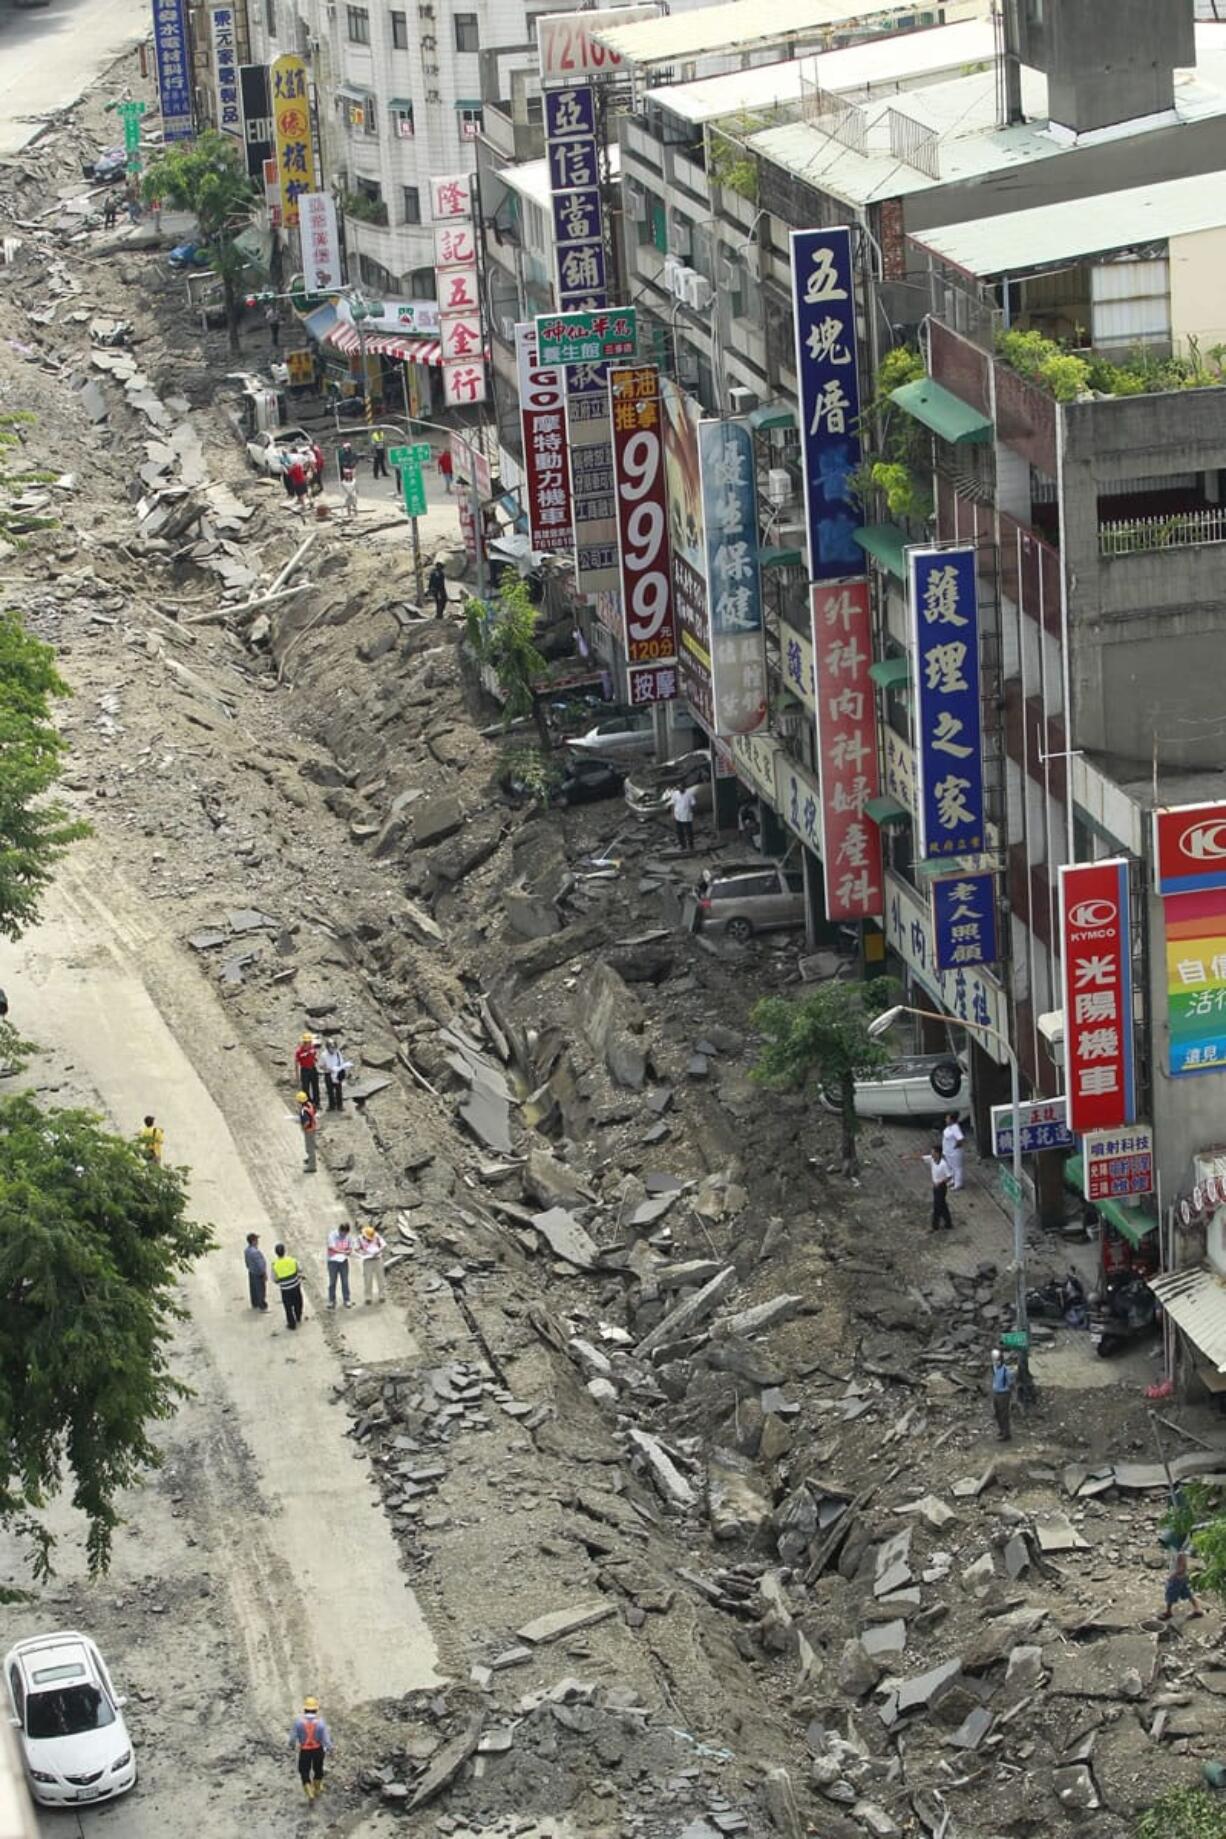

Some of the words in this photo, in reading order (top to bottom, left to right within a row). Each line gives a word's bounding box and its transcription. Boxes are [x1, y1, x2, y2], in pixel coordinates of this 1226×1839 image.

[437, 180, 482, 401] 隆記五金行
[553, 90, 609, 392] 亞信當鋪款
[532, 415, 567, 525] 摩特動力機車
[633, 671, 677, 702] 按摩
[922, 565, 977, 829] 護理之家
[948, 882, 984, 962] 老人照顧
[1071, 928, 1116, 942] KYMCO
[1075, 954, 1119, 1097] 光陽機車
